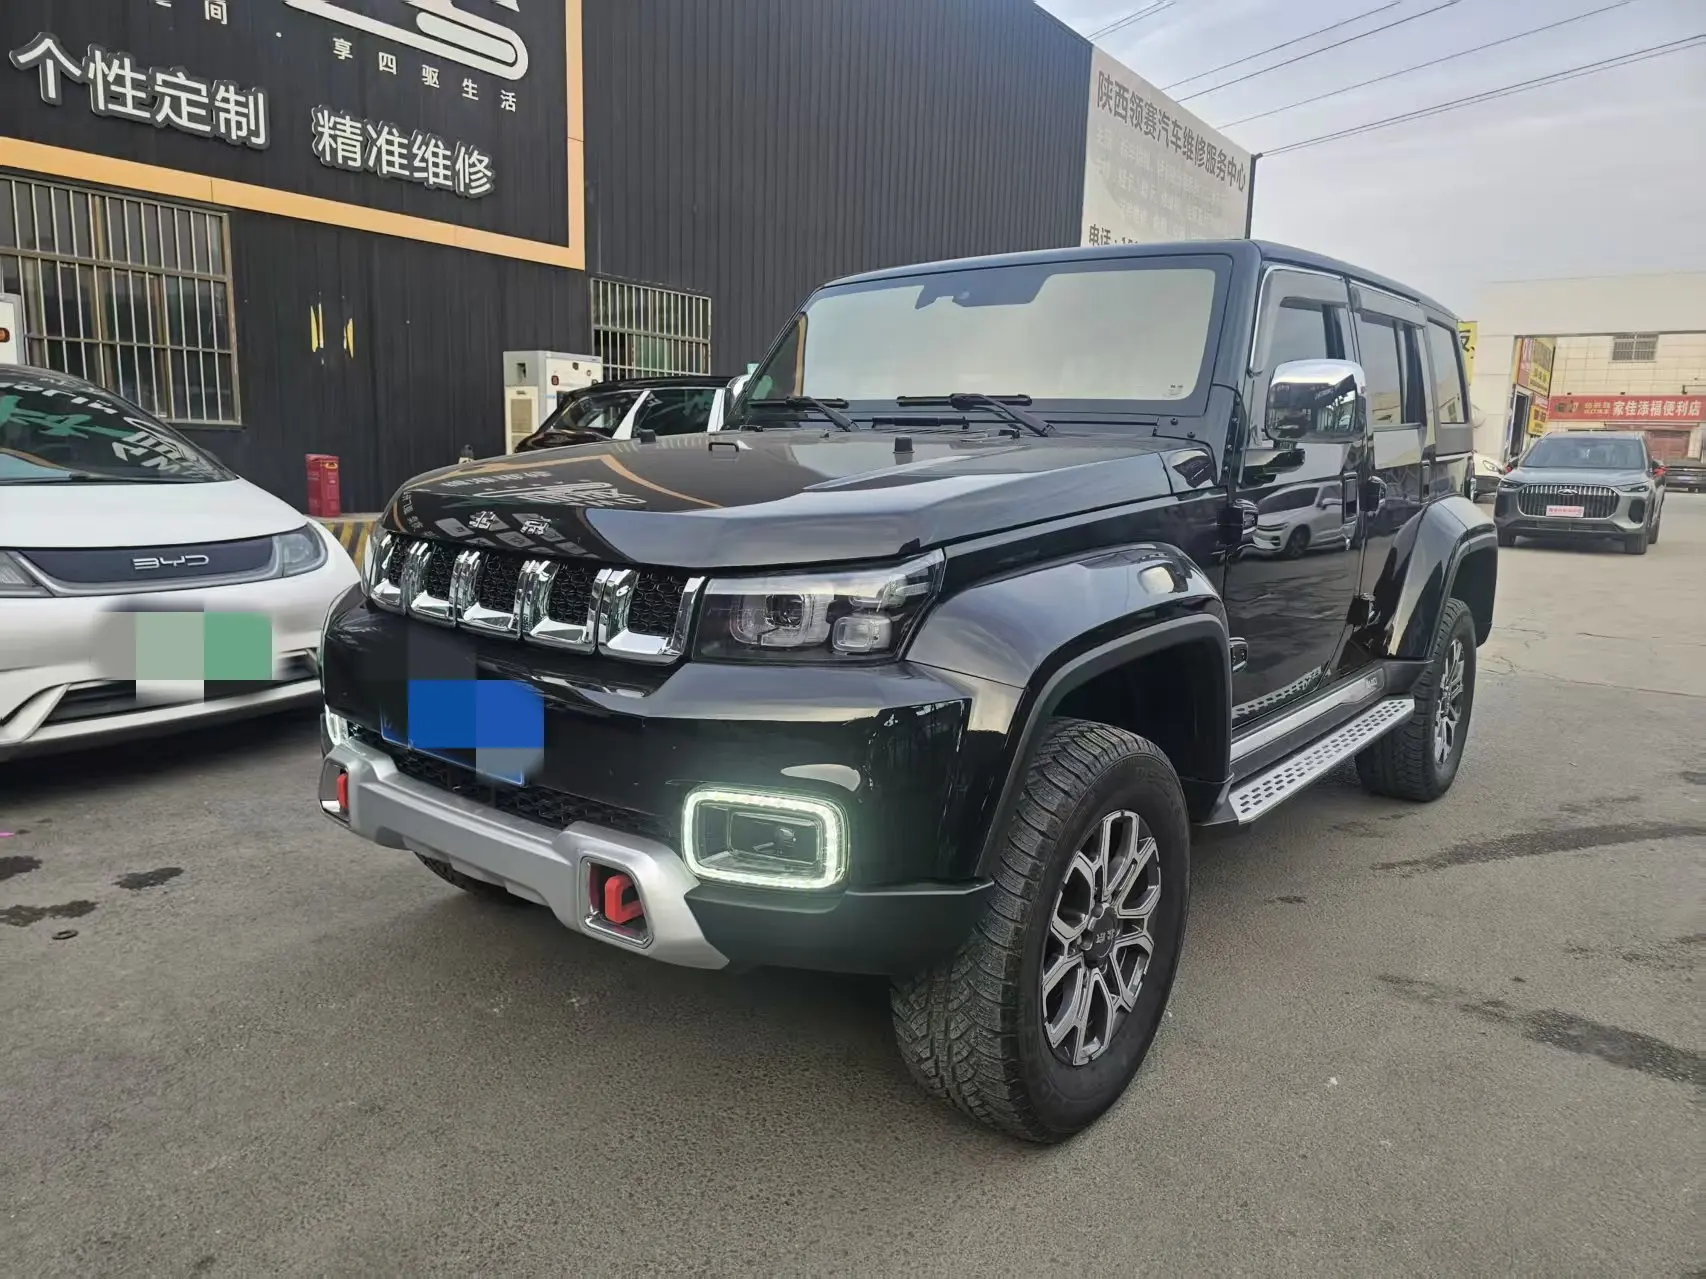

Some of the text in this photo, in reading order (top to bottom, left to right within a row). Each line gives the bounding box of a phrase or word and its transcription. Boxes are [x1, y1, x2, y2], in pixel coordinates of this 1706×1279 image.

[12, 33, 493, 196] 个性定制 精准维修
[1097, 71, 1246, 192] 陕西领赛汽车维修服务中心
[132, 554, 209, 571] BYD
